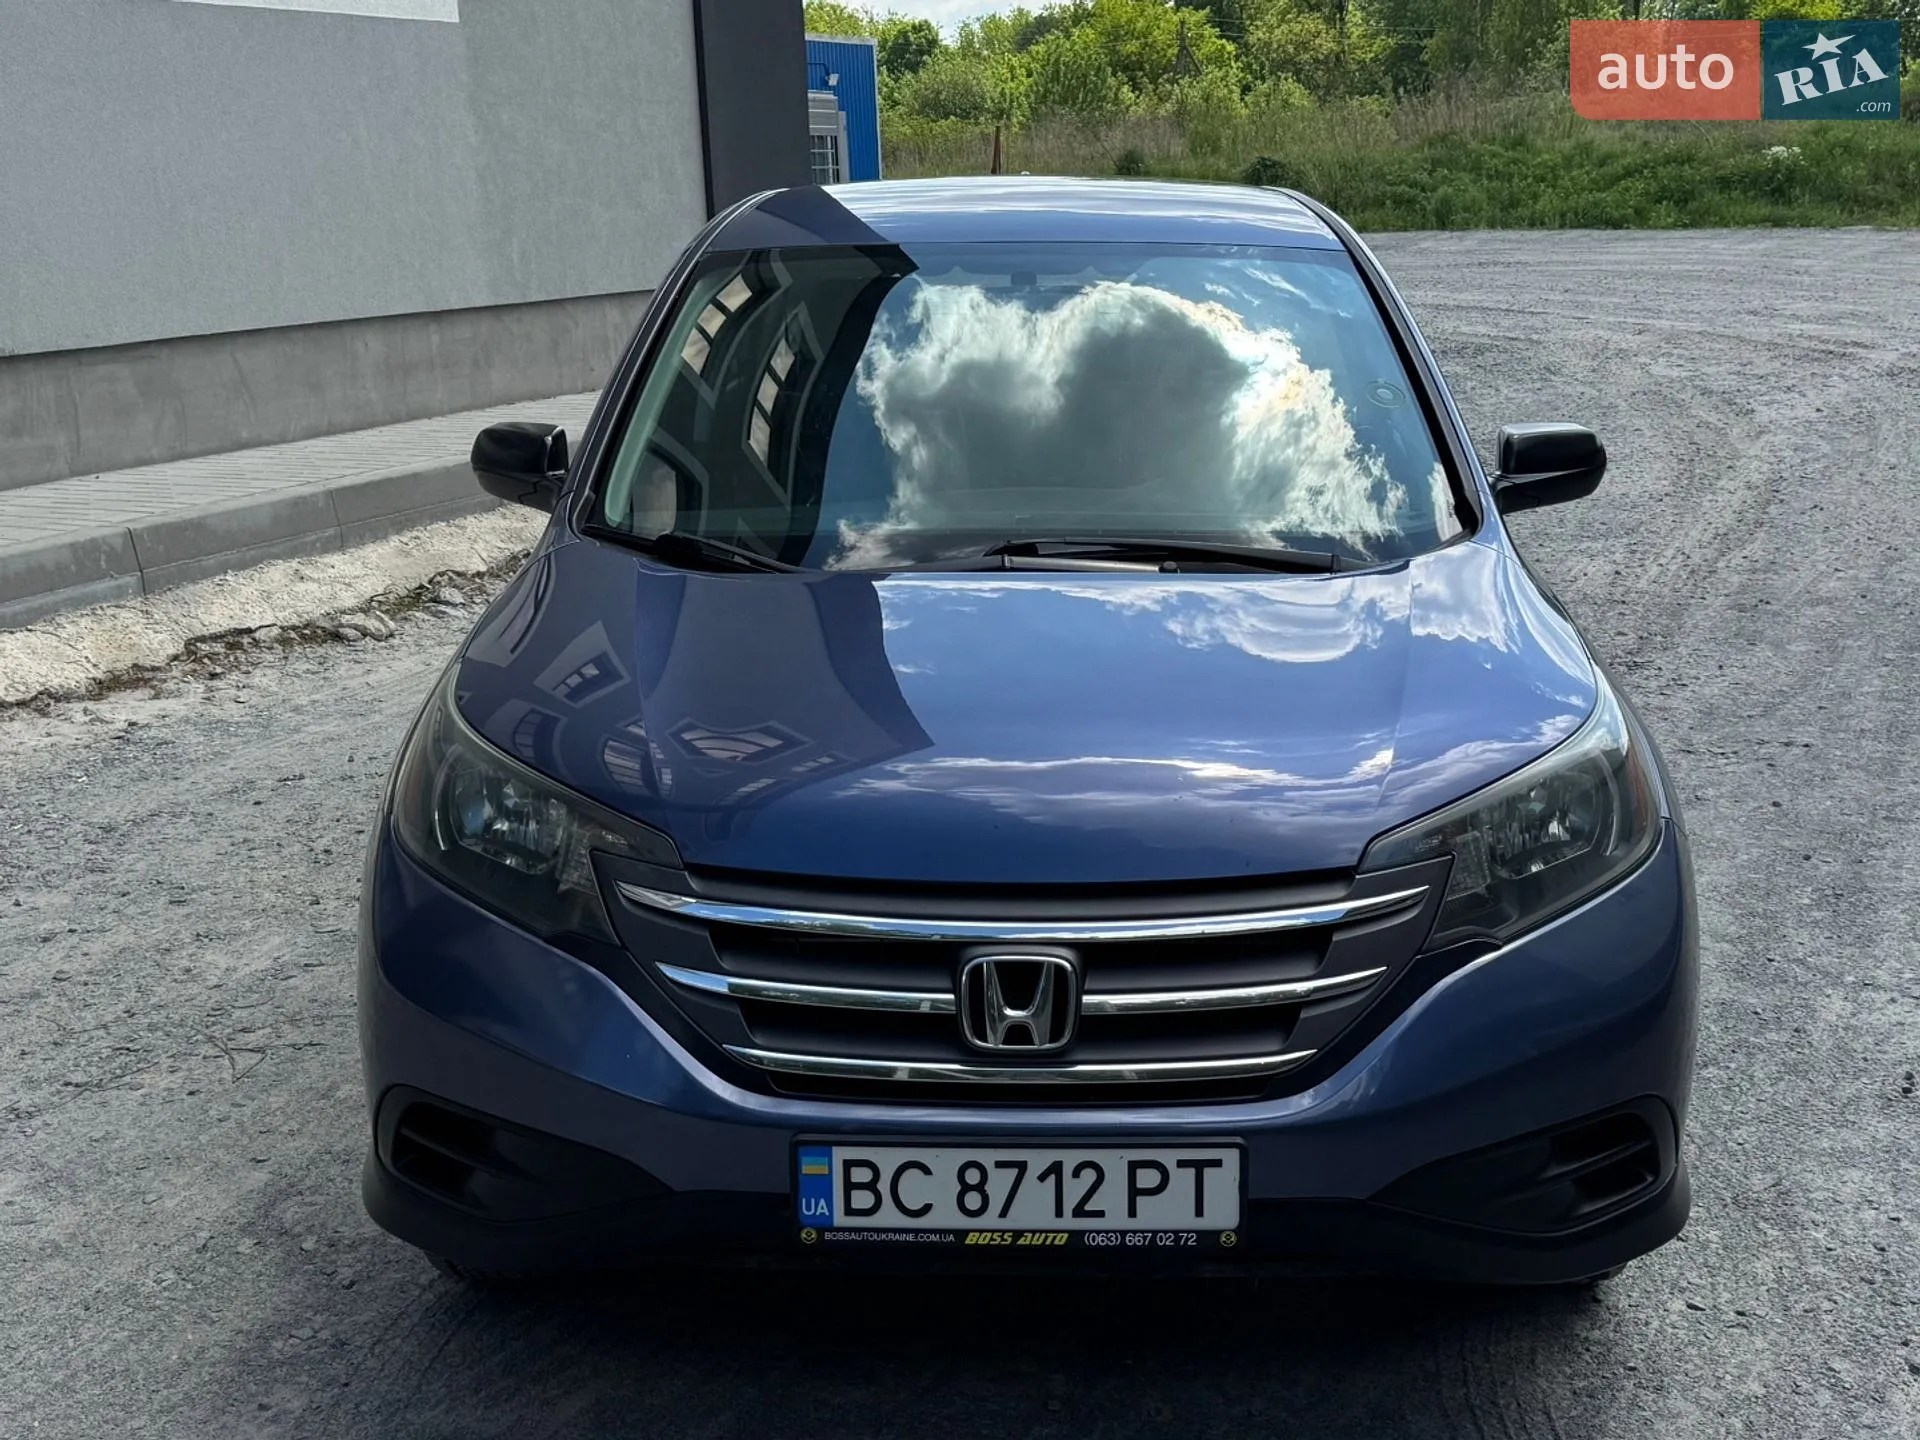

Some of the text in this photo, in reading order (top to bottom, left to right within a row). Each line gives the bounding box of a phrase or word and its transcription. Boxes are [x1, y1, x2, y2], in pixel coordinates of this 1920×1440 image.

[842, 1158, 1223, 1219] BC 8712 PT
[802, 1198, 829, 1216] UA
[824, 1231, 956, 1243] BOSSAUTOUKRAINE.COM.UA
[964, 1231, 1069, 1245] BOSS AUTO
[1084, 1232, 1197, 1247] (063) 667 02 72
